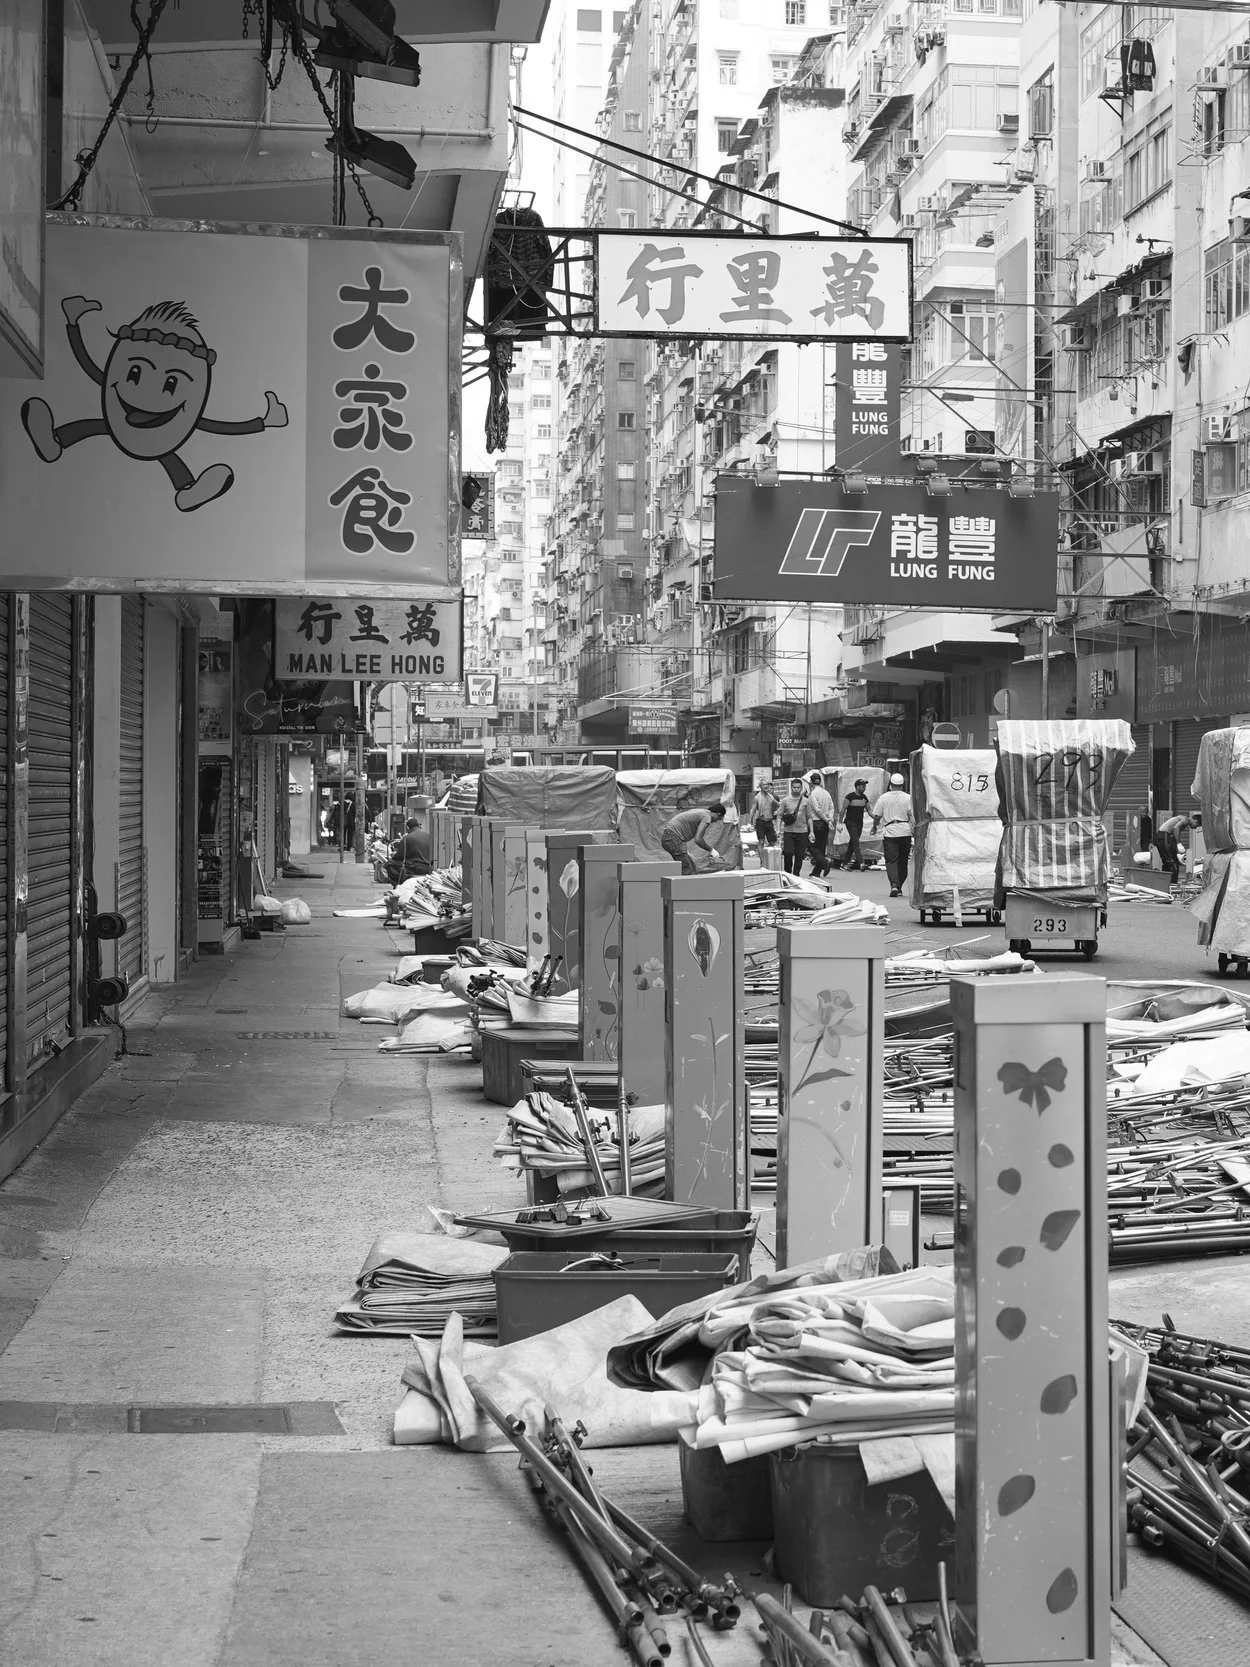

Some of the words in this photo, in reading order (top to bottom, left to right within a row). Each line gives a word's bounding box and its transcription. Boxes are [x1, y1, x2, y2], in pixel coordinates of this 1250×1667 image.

[852, 411, 888, 422] LUNG
[852, 424, 889, 435] FUNG
[890, 513, 996, 563] 龍豐
[890, 563, 938, 579] LUNG
[948, 565, 996, 581] FUNG
[289, 653, 333, 674] MAN
[341, 653, 381, 674] LEE
[391, 654, 445, 675] HONG
[1033, 751, 1102, 793] 293
[1033, 918, 1067, 933] 293
